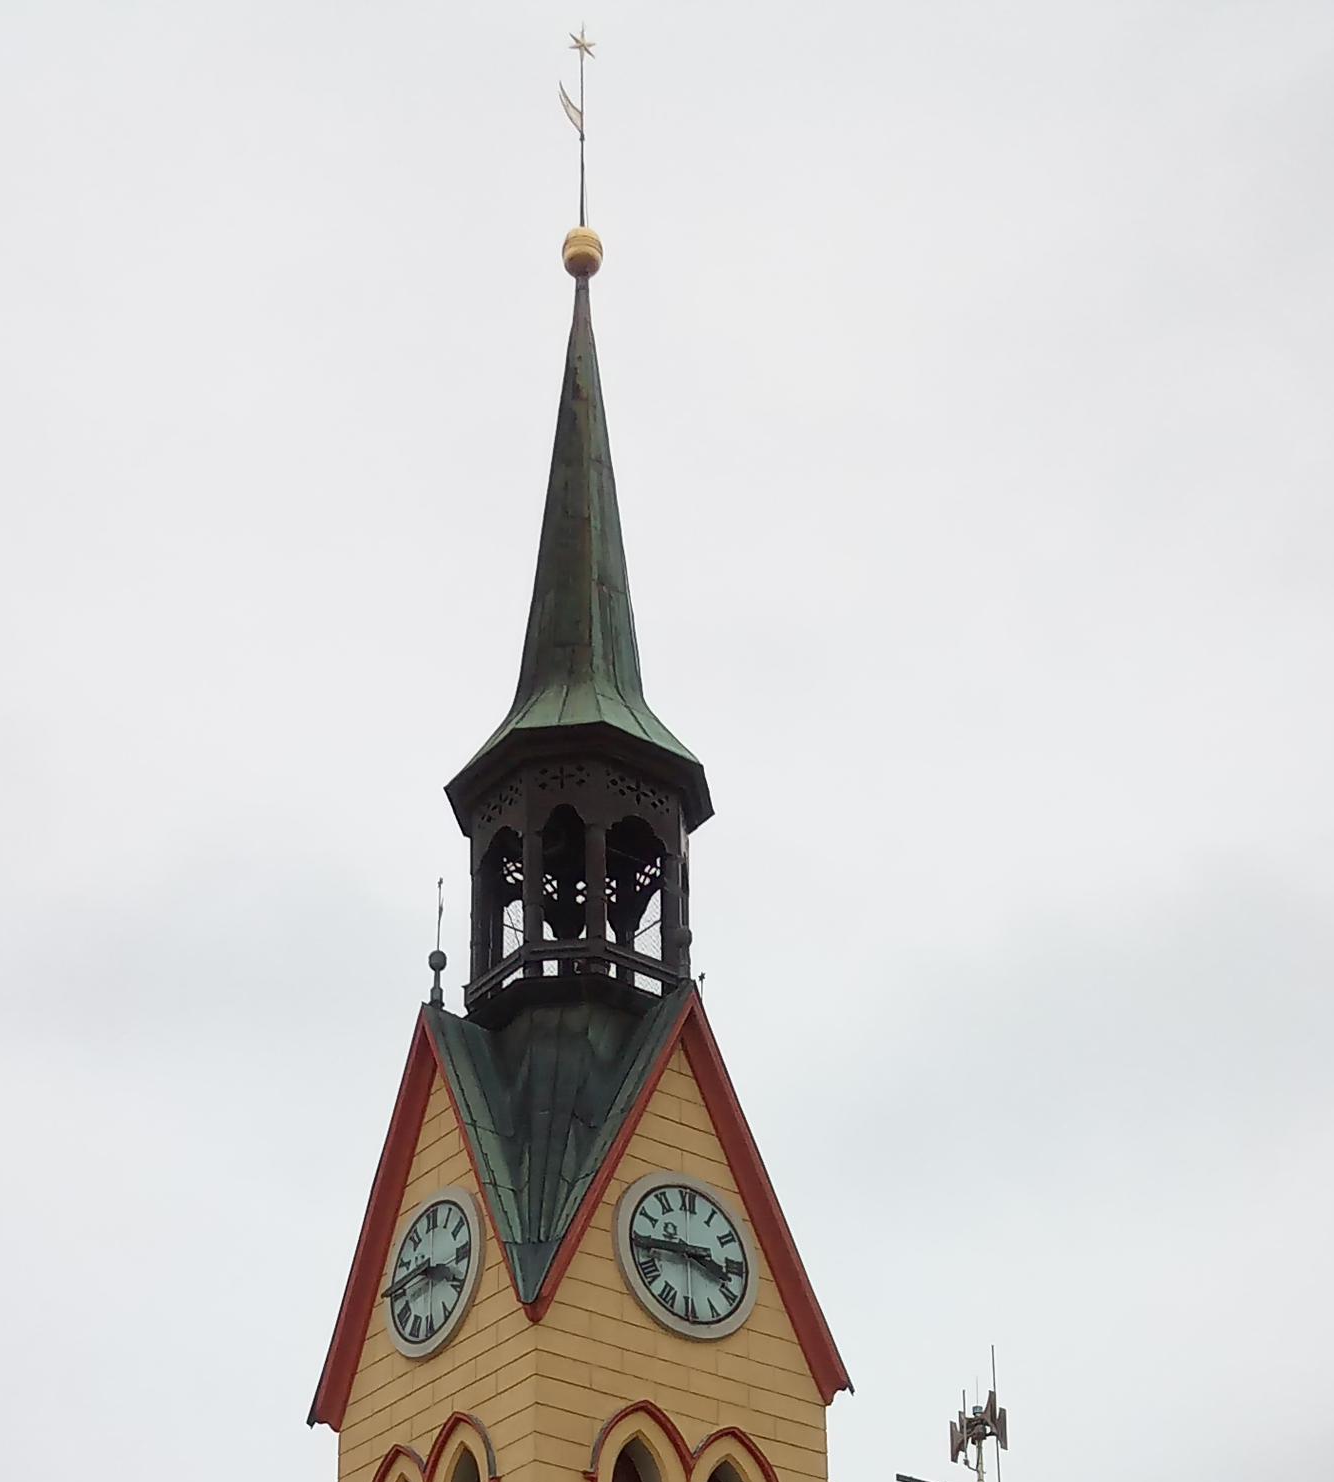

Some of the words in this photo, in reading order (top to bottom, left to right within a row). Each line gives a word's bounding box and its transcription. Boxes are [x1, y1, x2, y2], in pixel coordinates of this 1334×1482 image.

[654, 1191, 674, 1215] XI
[678, 1189, 697, 1215] XII
[443, 1207, 452, 1229] I
[639, 1206, 659, 1228] X
[704, 1208, 717, 1227] I
[451, 1216, 465, 1241] II
[716, 1230, 736, 1248] II
[658, 1281, 677, 1309] VII
[707, 1297, 721, 1318] V
